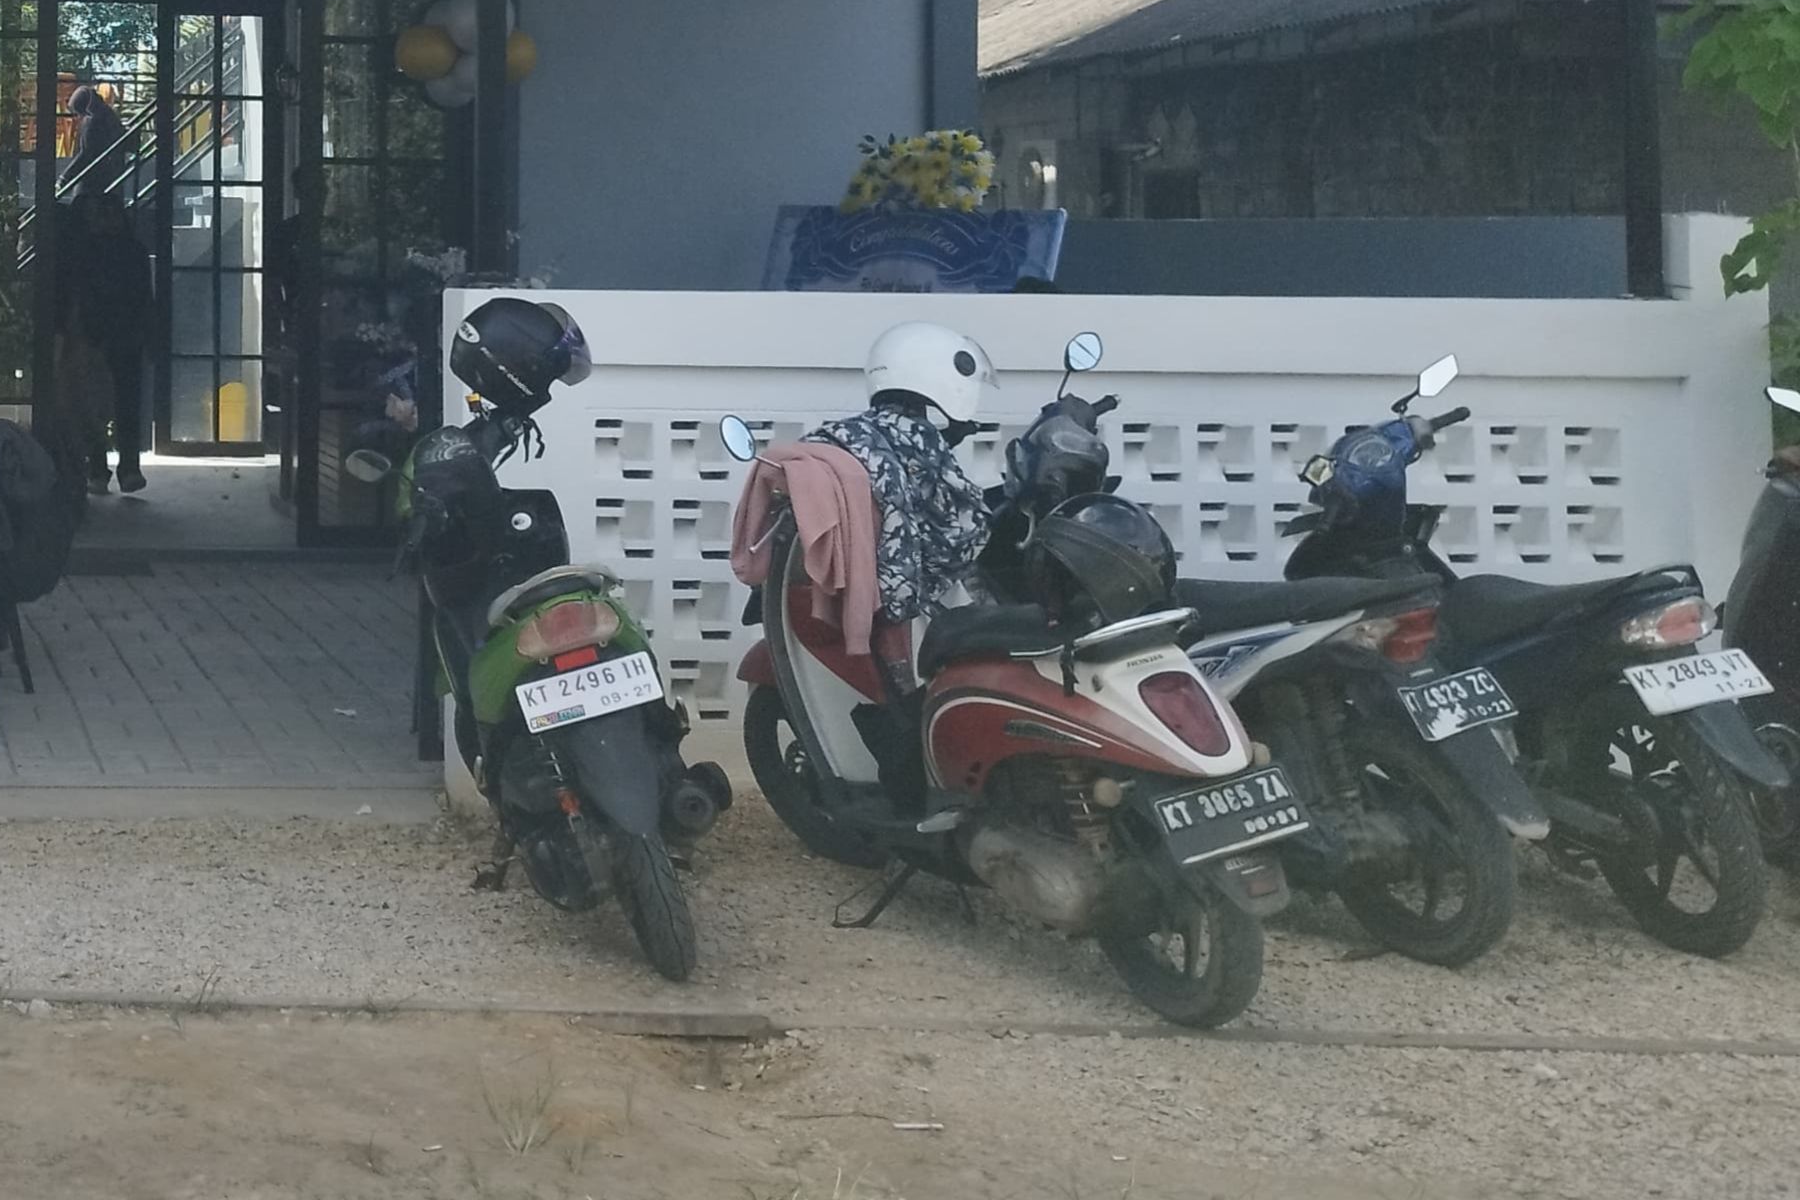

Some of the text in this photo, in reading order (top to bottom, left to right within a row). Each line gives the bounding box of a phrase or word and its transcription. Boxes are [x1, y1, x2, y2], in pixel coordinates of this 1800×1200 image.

[523, 658, 647, 708] KT 2496 IH
[1465, 672, 1495, 695] ZC
[1632, 653, 1748, 690] KT 2849 VT
[1161, 801, 1193, 830] KT
[1255, 774, 1289, 802] ZA
